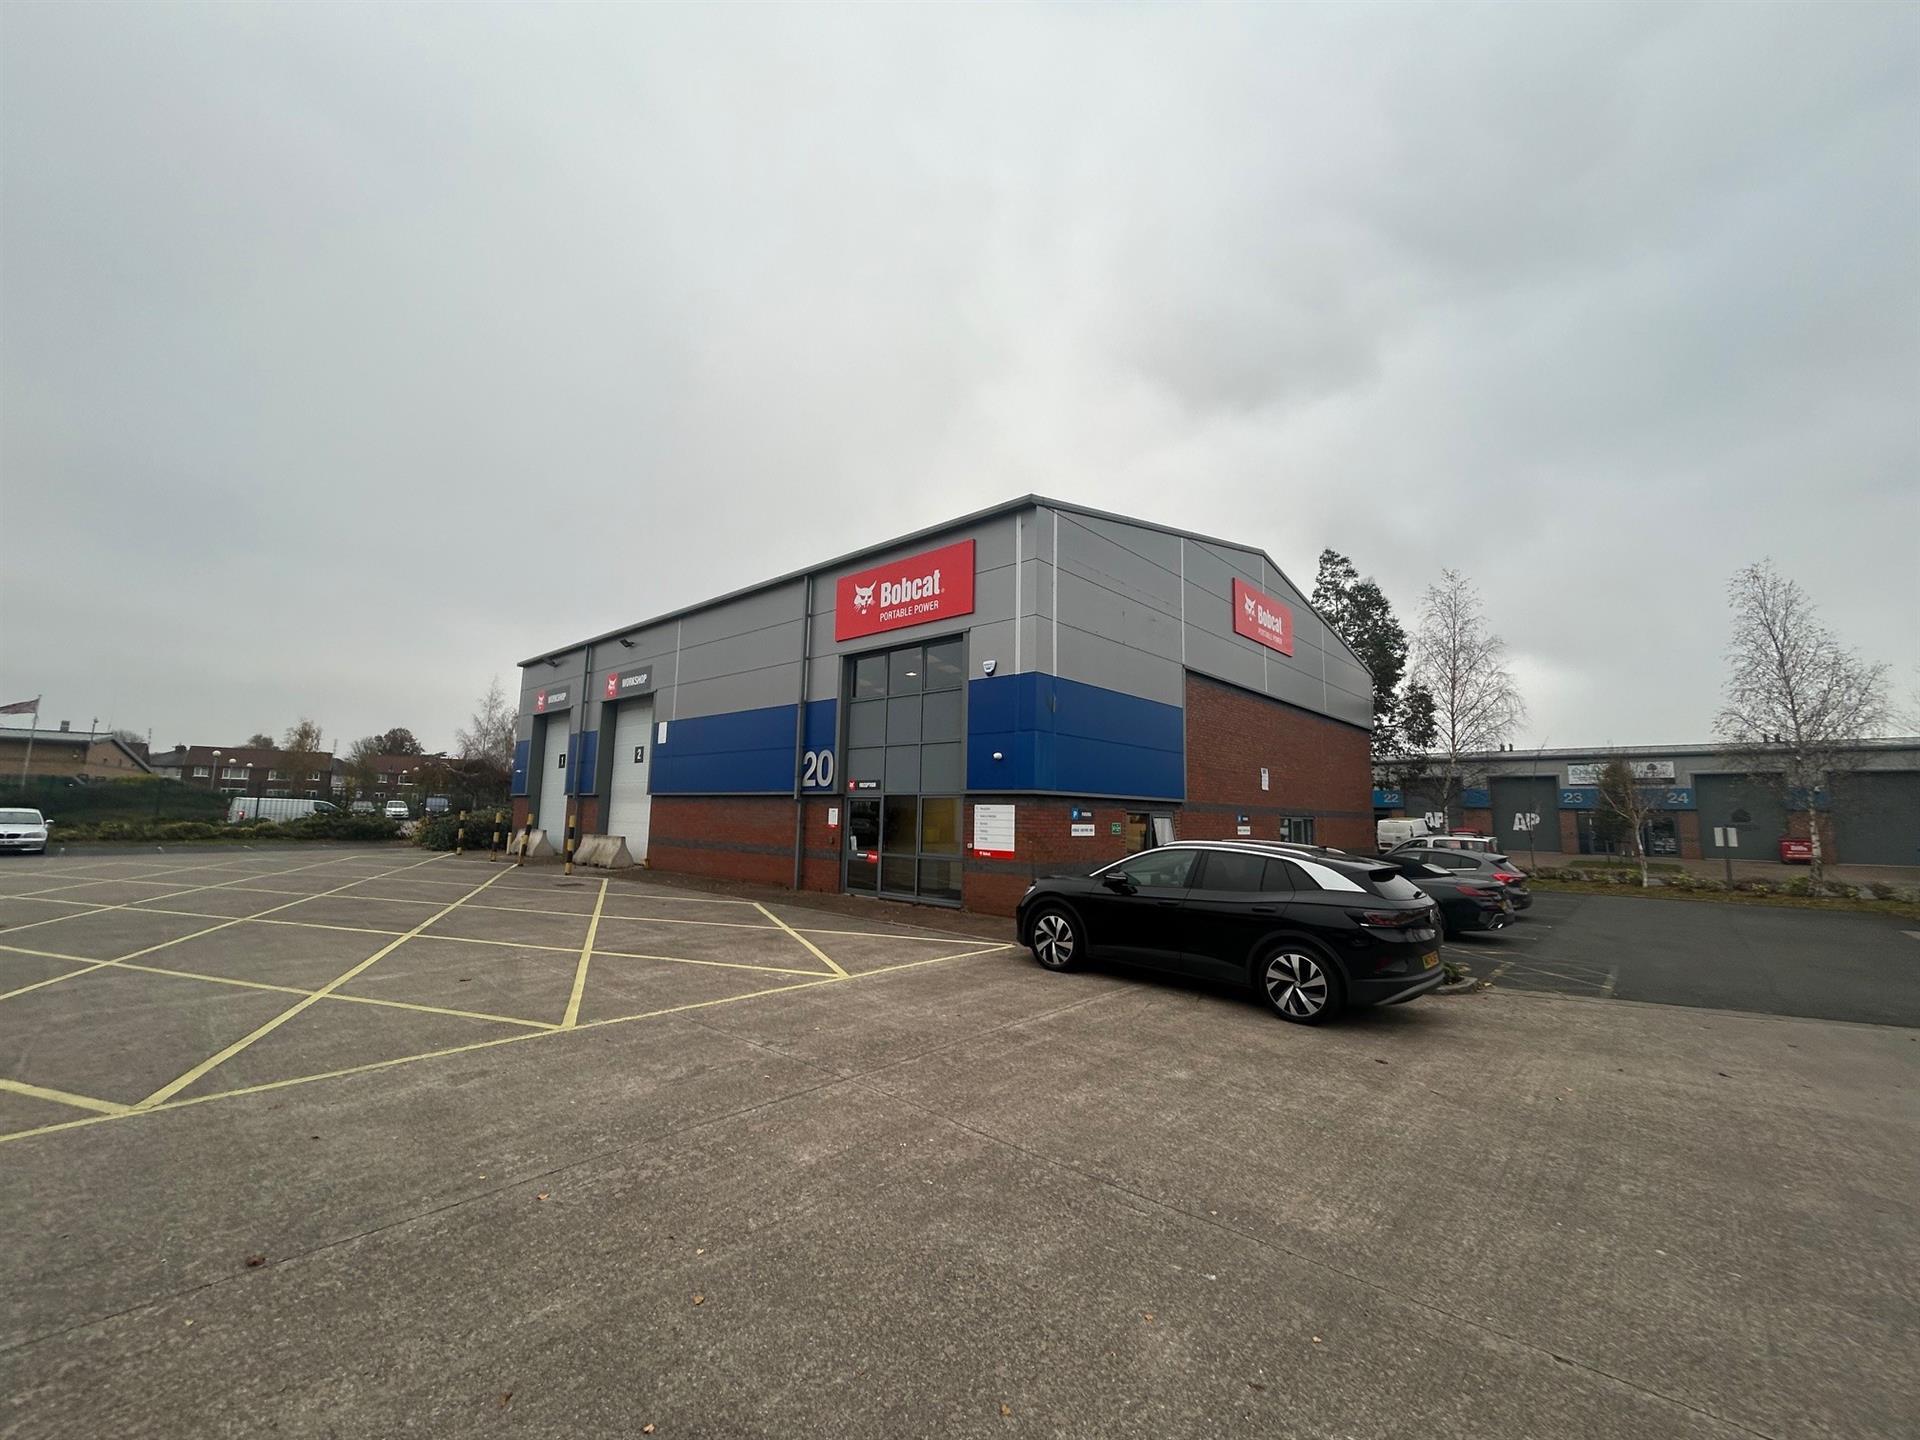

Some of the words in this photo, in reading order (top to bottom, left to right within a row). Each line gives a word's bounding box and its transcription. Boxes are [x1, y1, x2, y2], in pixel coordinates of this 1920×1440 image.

[880, 569, 941, 608] Bobcat
[879, 608, 913, 623] PORTABLE
[914, 600, 939, 614] POWER
[1257, 604, 1283, 635] Bobcat
[621, 673, 648, 688] WORKSHOP
[636, 748, 642, 760] 2
[802, 749, 834, 787] 20
[1383, 793, 1399, 803] 22
[1563, 792, 1584, 803] 23
[1666, 792, 1689, 804] 24
